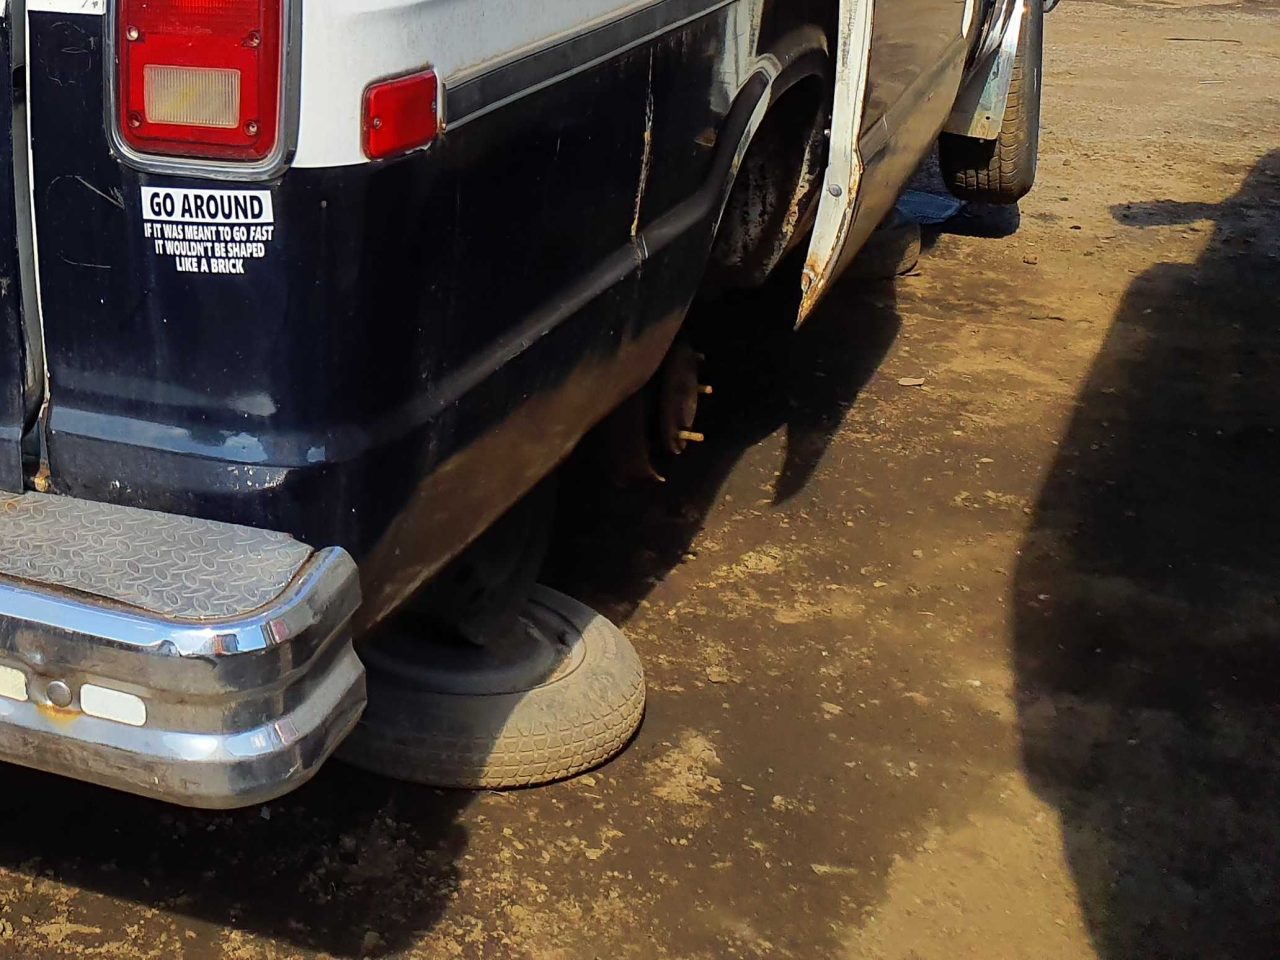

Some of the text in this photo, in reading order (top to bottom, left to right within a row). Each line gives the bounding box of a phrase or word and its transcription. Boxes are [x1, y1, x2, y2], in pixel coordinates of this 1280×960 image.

[150, 192, 263, 220] GO AROUND
[144, 222, 274, 241] IF IT WAS MEANT TO GO FAST
[154, 240, 265, 258] IT WOULDN'T BE SHAPED
[176, 256, 245, 274] LIKE A BRICK
